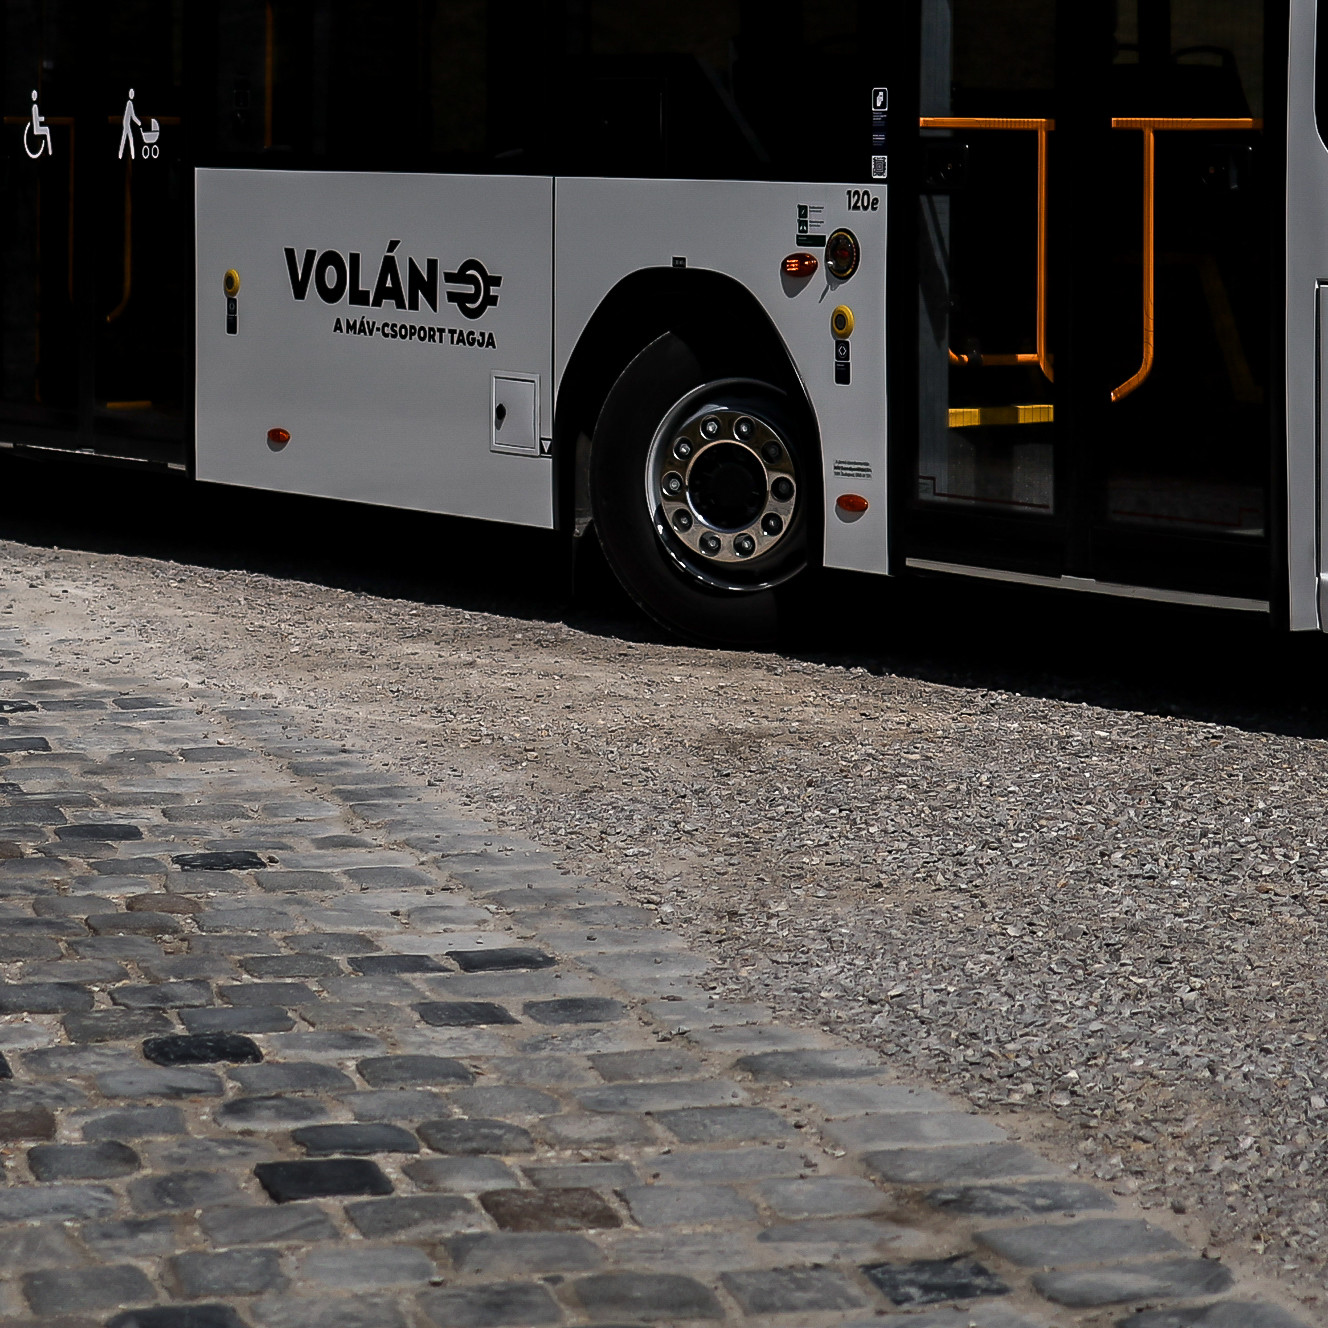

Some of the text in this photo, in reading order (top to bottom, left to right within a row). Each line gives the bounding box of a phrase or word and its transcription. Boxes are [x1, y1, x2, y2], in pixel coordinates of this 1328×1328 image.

[846, 189, 879, 211] 120e
[283, 239, 439, 314] VOLÁN
[333, 315, 497, 350] A MÁV-CSOPORT TAGJA
